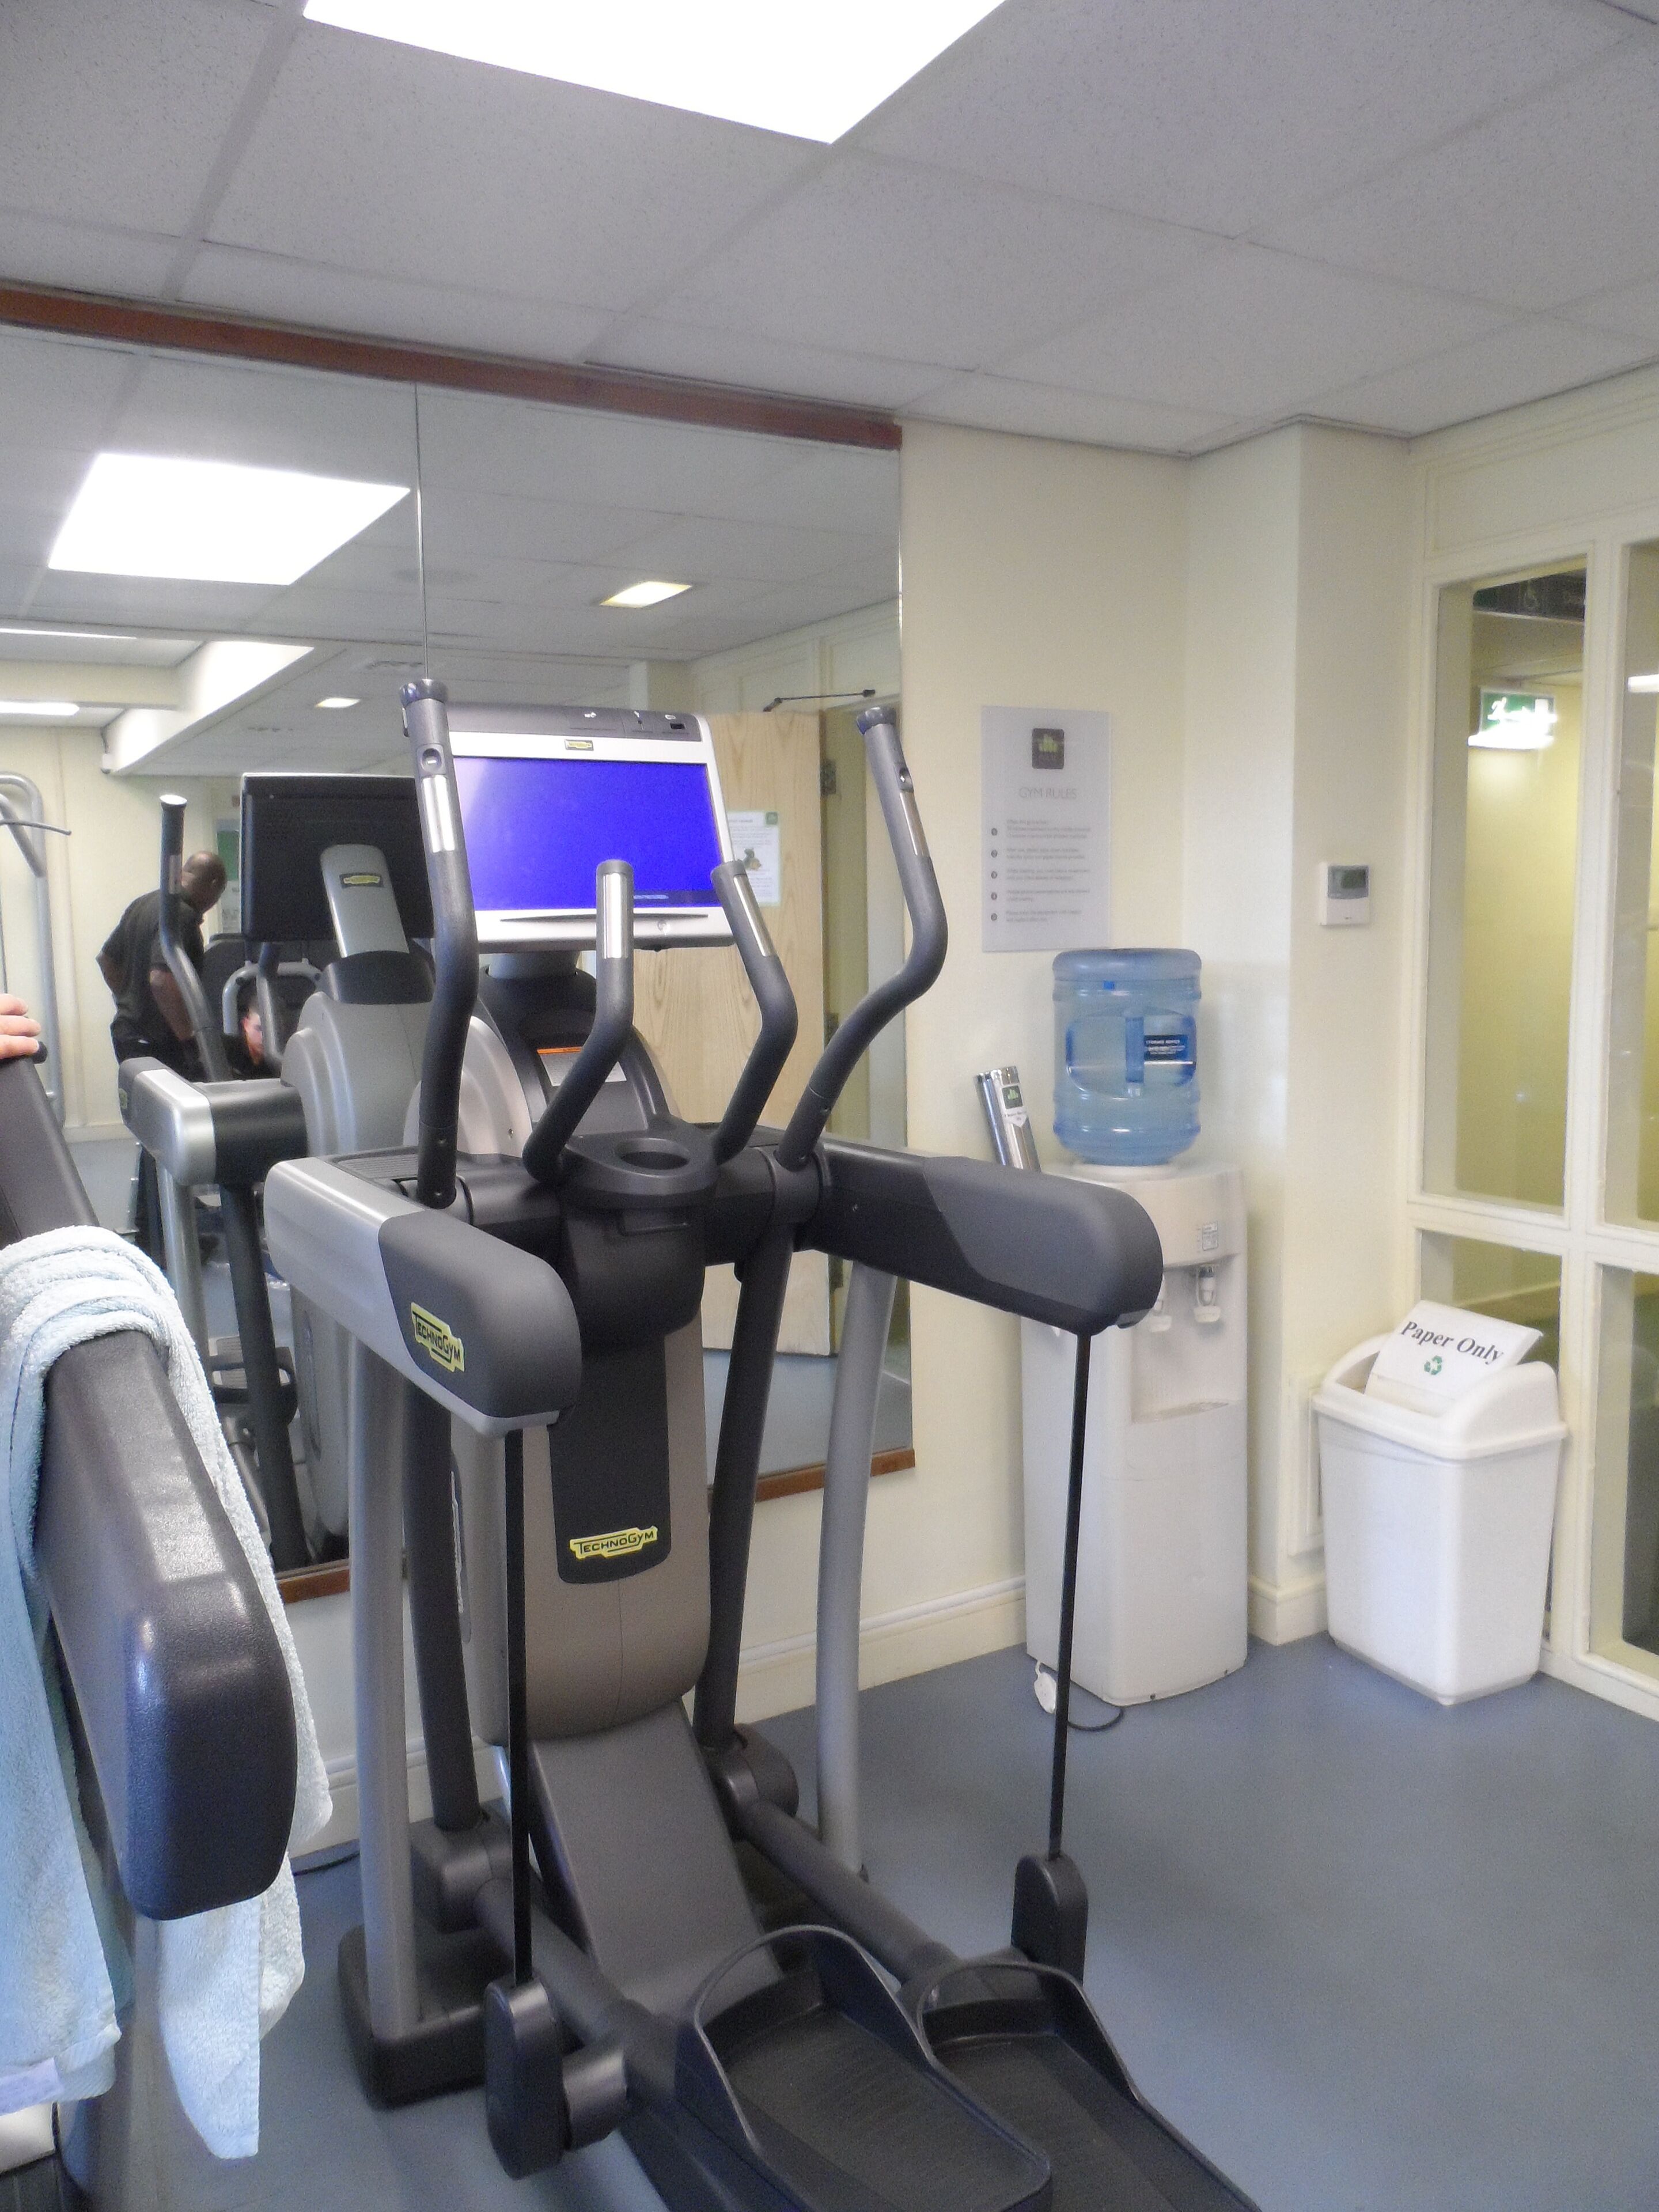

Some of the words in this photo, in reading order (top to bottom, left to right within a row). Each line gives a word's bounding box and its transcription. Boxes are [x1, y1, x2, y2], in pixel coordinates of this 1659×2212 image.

[1019, 787, 1042, 798] GYM
[1046, 787, 1077, 800] RULES
[1401, 1321, 1454, 1346] Paper
[1456, 1337, 1504, 1365] Only
